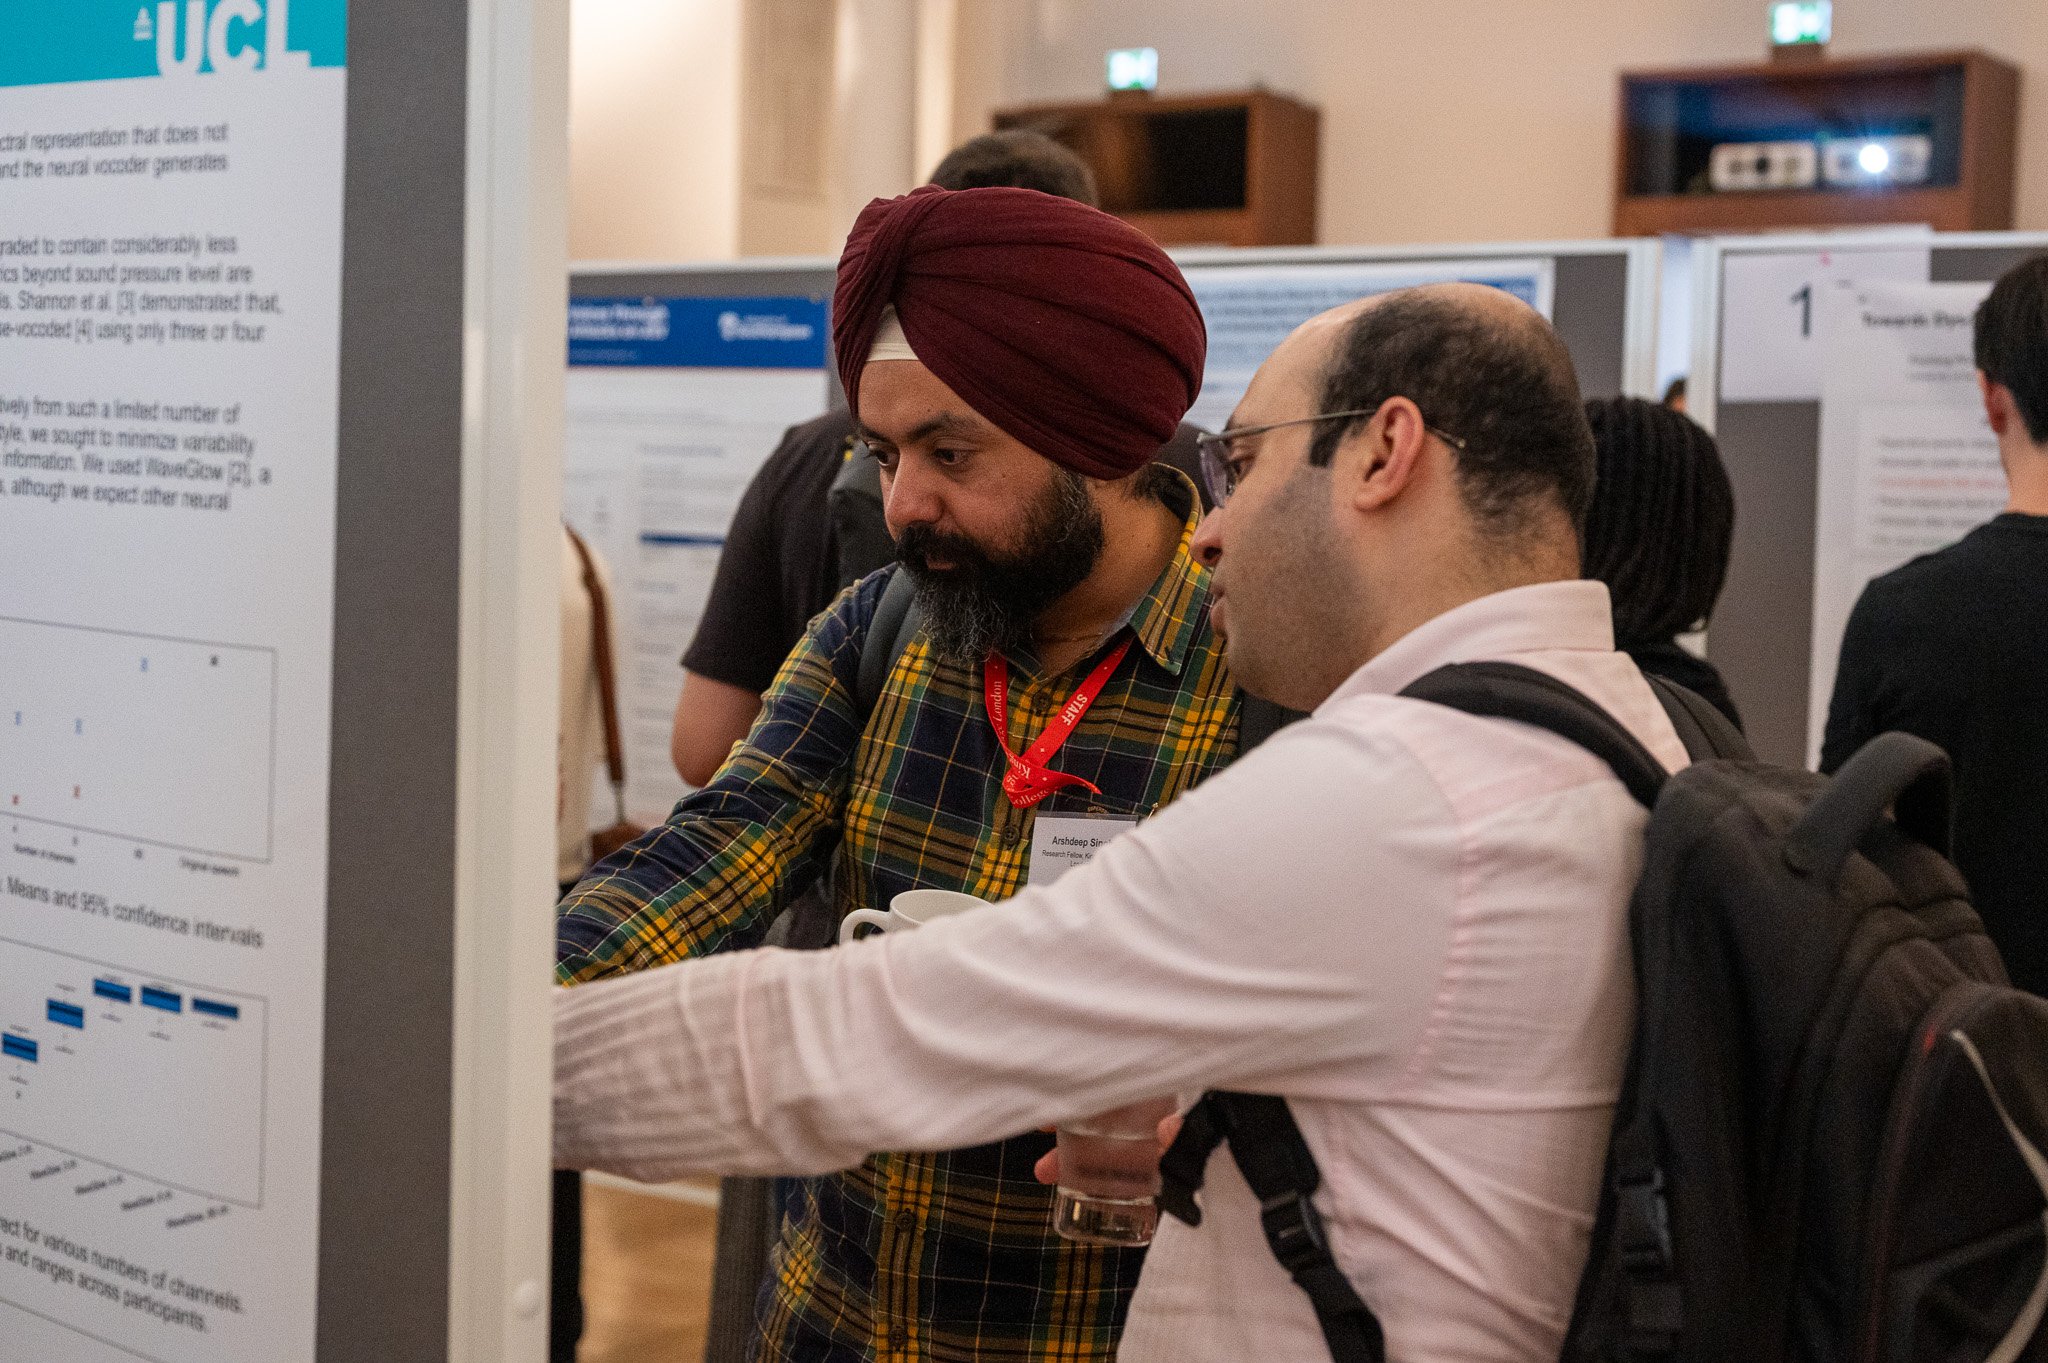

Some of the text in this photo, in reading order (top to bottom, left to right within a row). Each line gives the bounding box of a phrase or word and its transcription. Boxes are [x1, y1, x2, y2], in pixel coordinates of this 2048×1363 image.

[156, 0, 310, 77] UCL
[30, 128, 127, 152] representation
[132, 126, 160, 147] that
[164, 124, 198, 144] does
[203, 122, 228, 142] not
[22, 157, 42, 177] the
[47, 155, 89, 177] neural
[93, 154, 148, 175] vocoder
[153, 153, 228, 179] generates
[0, 233, 238, 258] raded to contain considerably less
[22, 264, 72, 288] beyond
[75, 264, 117, 283] sound
[119, 266, 182, 286] pressure
[187, 263, 221, 283] level
[225, 266, 253, 283] are
[17, 289, 77, 311] Shannon
[139, 293, 241, 313] demonstrated
[1791, 283, 1812, 340] 1
[96, 321, 134, 345] using
[136, 321, 165, 346] only
[169, 319, 208, 341] three
[211, 323, 228, 341] or
[232, 319, 266, 342] four
[33, 396, 61, 416] from
[67, 399, 96, 418] such
[102, 401, 111, 419] a
[115, 399, 160, 421] limited
[163, 401, 219, 423] number
[222, 402, 241, 425] of
[29, 425, 48, 442] we
[53, 428, 96, 450] sought
[100, 428, 112, 447] to
[182, 431, 255, 459] variability
[81, 452, 103, 474] We
[107, 455, 142, 476] used
[146, 456, 223, 481] WaveGlow
[258, 467, 272, 485] a
[11, 475, 65, 504] although
[71, 483, 90, 501] we
[93, 484, 139, 507] expect
[142, 484, 178, 507] other
[181, 489, 232, 512] neural
[990, 681, 1002, 722] London
[1061, 693, 1088, 726] STAFF
[1042, 849, 1066, 859] Research
[1066, 851, 1084, 860] Fellow,
[1052, 836, 1112, 848] Arshdeep Sin
[7, 875, 49, 903] Means
[53, 888, 78, 911] and
[113, 903, 190, 935] confidence
[195, 919, 264, 949] intervals
[22, 1220, 41, 1245] for
[43, 1230, 88, 1265] various
[91, 1247, 149, 1287] numbers
[152, 1269, 167, 1292] of
[169, 1277, 244, 1315] channels.
[5, 1245, 208, 1333] and ranges across participants.
